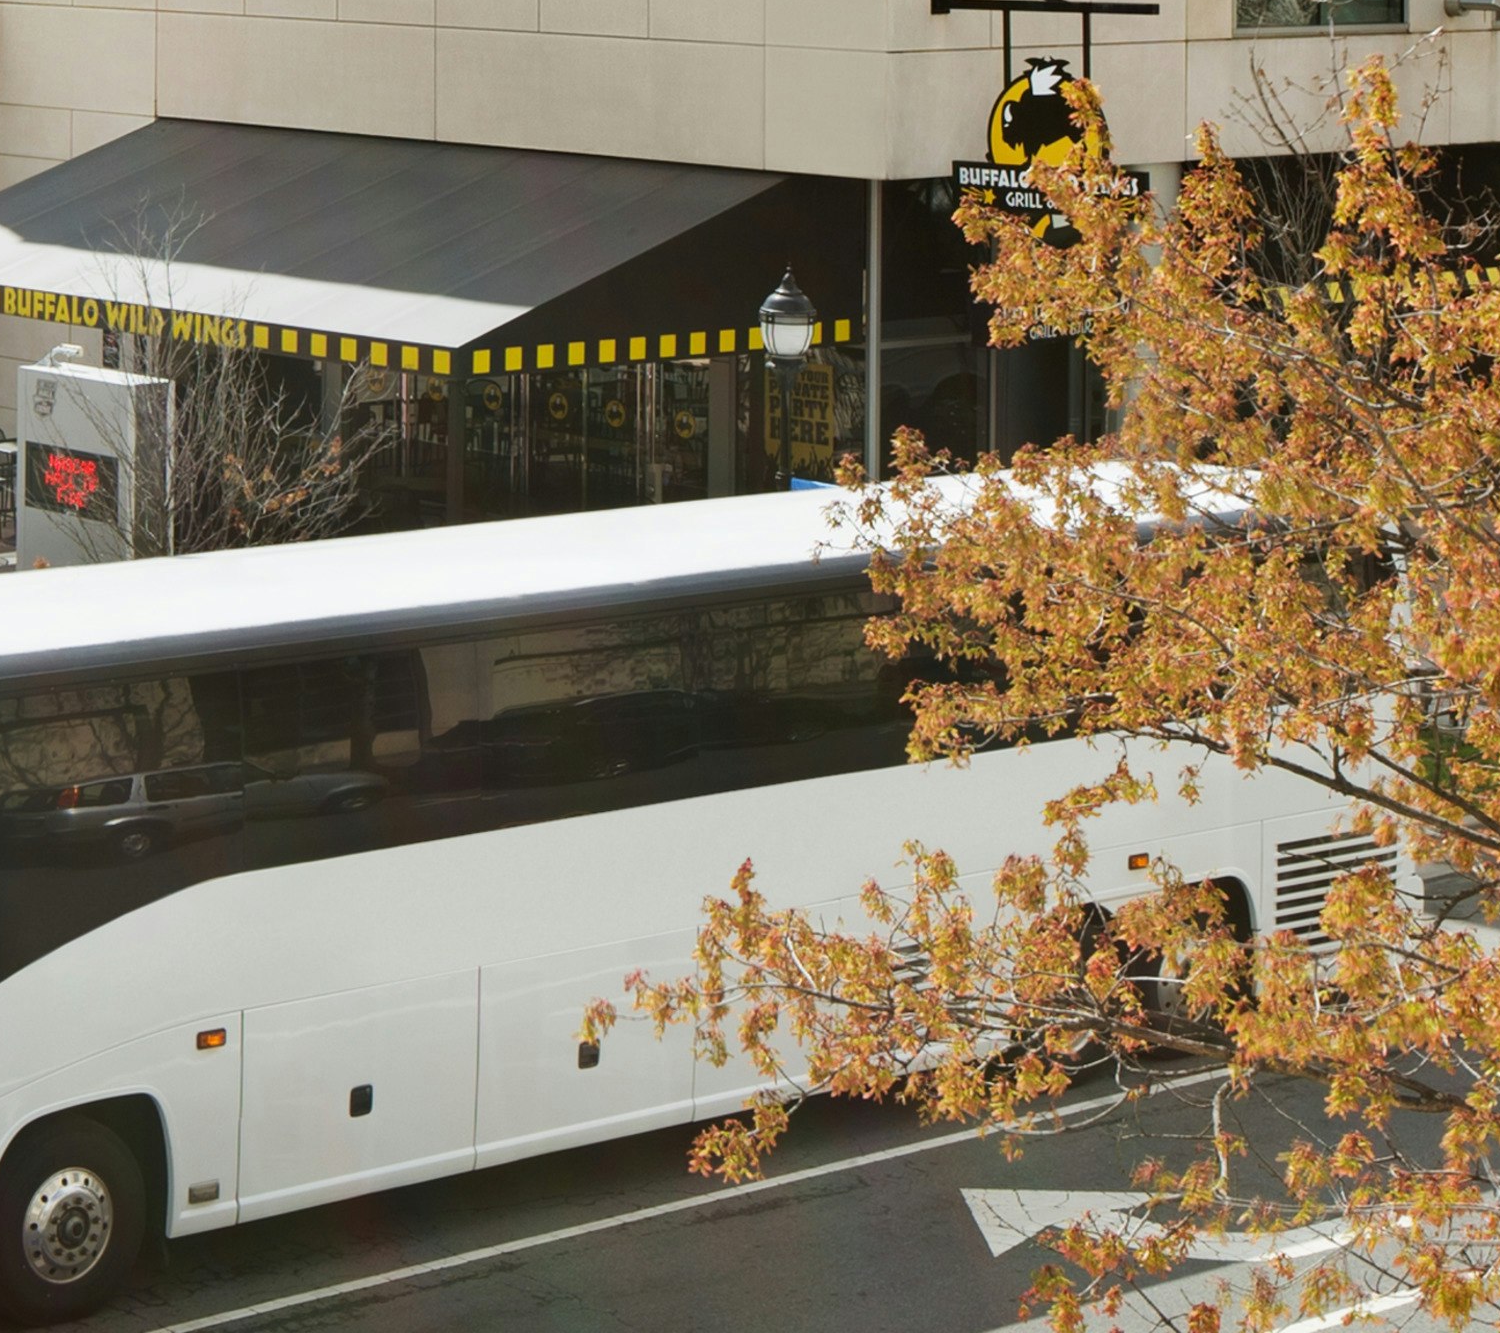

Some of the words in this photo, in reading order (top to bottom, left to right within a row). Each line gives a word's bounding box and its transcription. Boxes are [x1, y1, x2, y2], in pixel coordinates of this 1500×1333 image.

[1005, 191, 1043, 209] GRILL
[3, 286, 99, 328] BUFFALO
[105, 300, 165, 337] WILD
[171, 310, 247, 350] WINGS
[769, 395, 830, 420] PRTY
